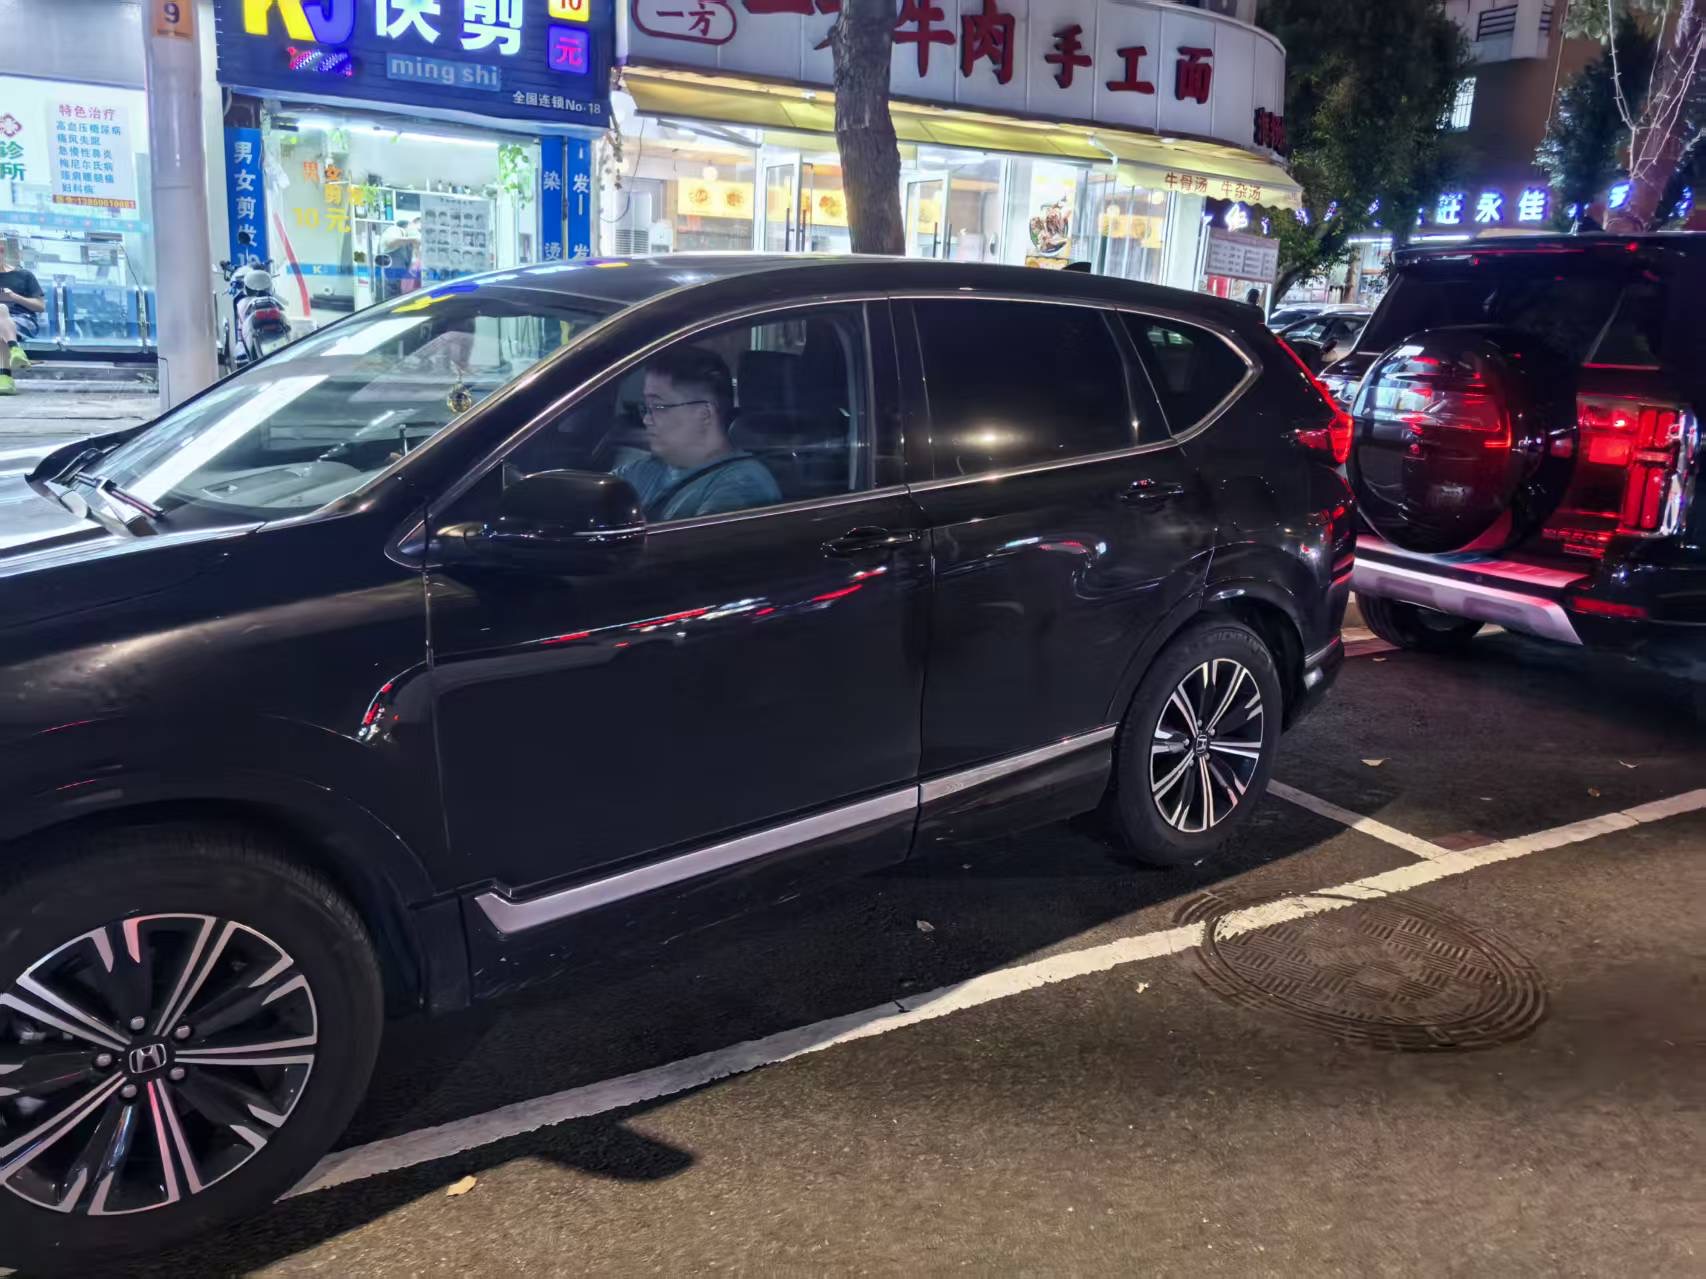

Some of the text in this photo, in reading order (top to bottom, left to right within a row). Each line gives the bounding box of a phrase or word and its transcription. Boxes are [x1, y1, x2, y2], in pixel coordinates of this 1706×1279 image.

[163, 3, 180, 24] 9
[656, 2, 716, 36] 一方
[554, 37, 583, 65] 元
[391, 57, 498, 86] ming shi
[59, 104, 116, 121] 特色治疗
[1164, 171, 1209, 193] 牛骨汤
[1221, 180, 1263, 202] 牛杂汤
